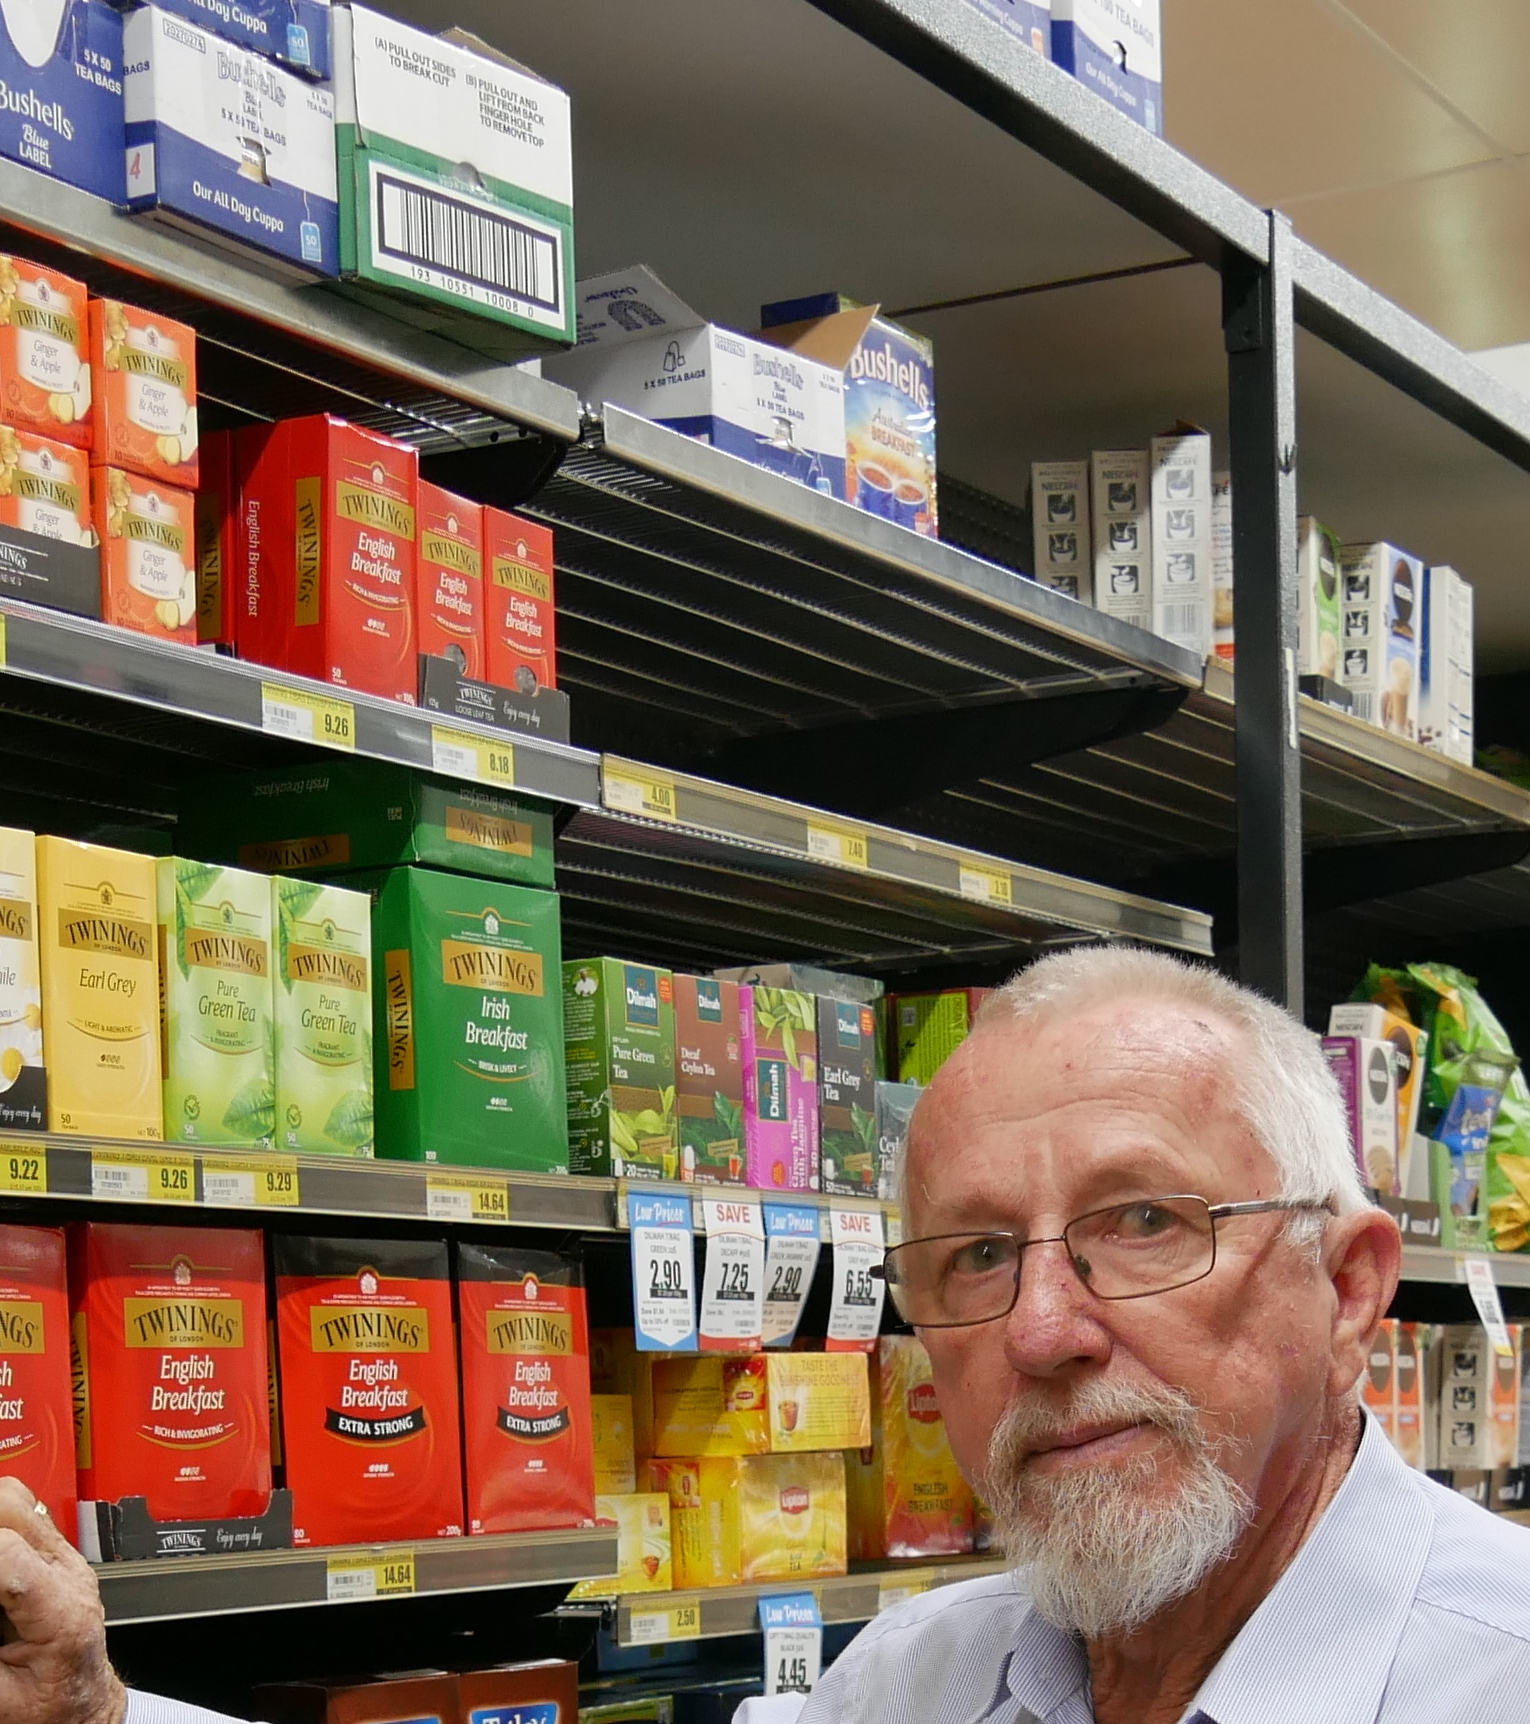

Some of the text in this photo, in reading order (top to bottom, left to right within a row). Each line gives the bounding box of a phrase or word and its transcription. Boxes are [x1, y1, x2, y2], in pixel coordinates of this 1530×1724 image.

[84, 49, 112, 72] 5 X 50
[374, 37, 457, 78] (A) PULL OUT SIDES
[389, 54, 450, 88] TO BREAK CUT
[75, 64, 122, 96] TEA BAGS
[479, 78, 499, 96] PULL
[500, 86, 517, 102] OUT
[518, 93, 538, 111] AND
[479, 91, 544, 126] LIFT FROM BACK
[479, 103, 533, 133] FINGER HOLE
[480, 114, 544, 147] TO REMOVE TOP
[193, 180, 284, 233] Our All Day Cuppa
[850, 344, 930, 410] Bushells
[341, 494, 410, 534] TWININGS
[246, 498, 263, 619] English Breakfast
[358, 531, 396, 559] English
[351, 554, 402, 586] Breakfast
[324, 714, 349, 737] 9.26
[216, 980, 239, 999] Pure
[626, 988, 657, 1009] Dilmah
[198, 995, 256, 1023] Green Tea
[481, 996, 510, 1020] Irish
[465, 1021, 528, 1051] Breakfast
[10, 1158, 39, 1181] 9.22
[716, 1205, 750, 1224] SAVE
[650, 1259, 681, 1287] 2.90
[721, 1262, 749, 1289] 7.25
[337, 1416, 413, 1435] EXTRA STRONG
[382, 1564, 412, 1584] 14.64
[777, 1658, 806, 1685] 4.45
